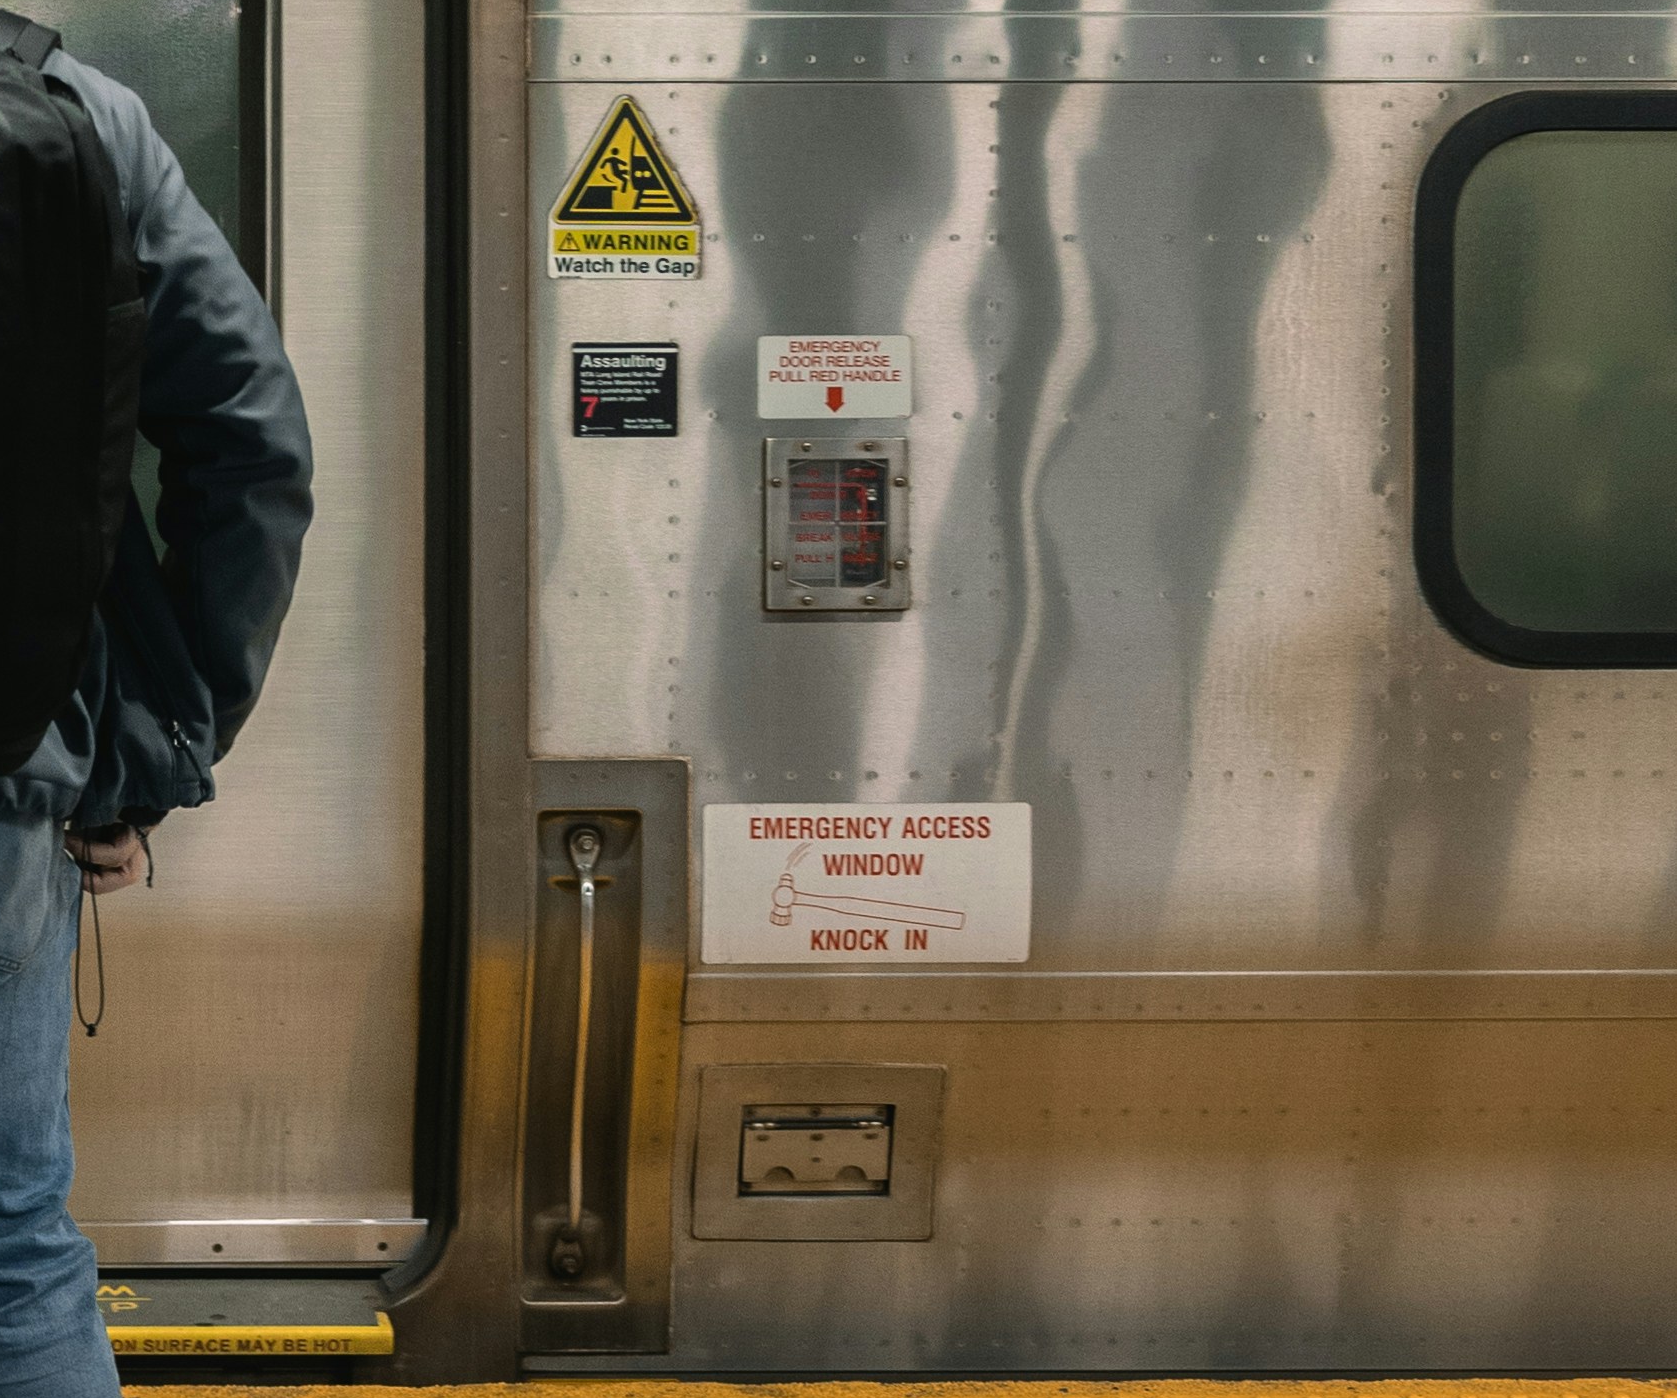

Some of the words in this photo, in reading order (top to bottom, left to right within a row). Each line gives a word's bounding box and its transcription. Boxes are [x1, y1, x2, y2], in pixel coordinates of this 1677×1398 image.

[582, 233, 689, 251] WARNING
[554, 257, 614, 273] Watch
[620, 257, 650, 273] the
[656, 257, 695, 277] Gap
[788, 340, 881, 353] EMERGENCY
[580, 354, 667, 371] Assaulting
[779, 355, 822, 368] DOOR
[825, 355, 891, 368] RELEASE
[768, 370, 806, 383] PULL
[809, 370, 839, 382] RED
[842, 370, 902, 382] HANDLE
[580, 396, 600, 418] 7
[749, 817, 892, 839] EMERGENCY
[901, 816, 991, 839] ACCESS
[823, 853, 924, 876] WINDOW
[810, 929, 889, 951] KNOCK
[905, 929, 928, 951] IN
[142, 1338, 231, 1353] SURFACE
[236, 1338, 274, 1353] MAY
[283, 1338, 308, 1352] BE
[314, 1338, 352, 1352] HOT
